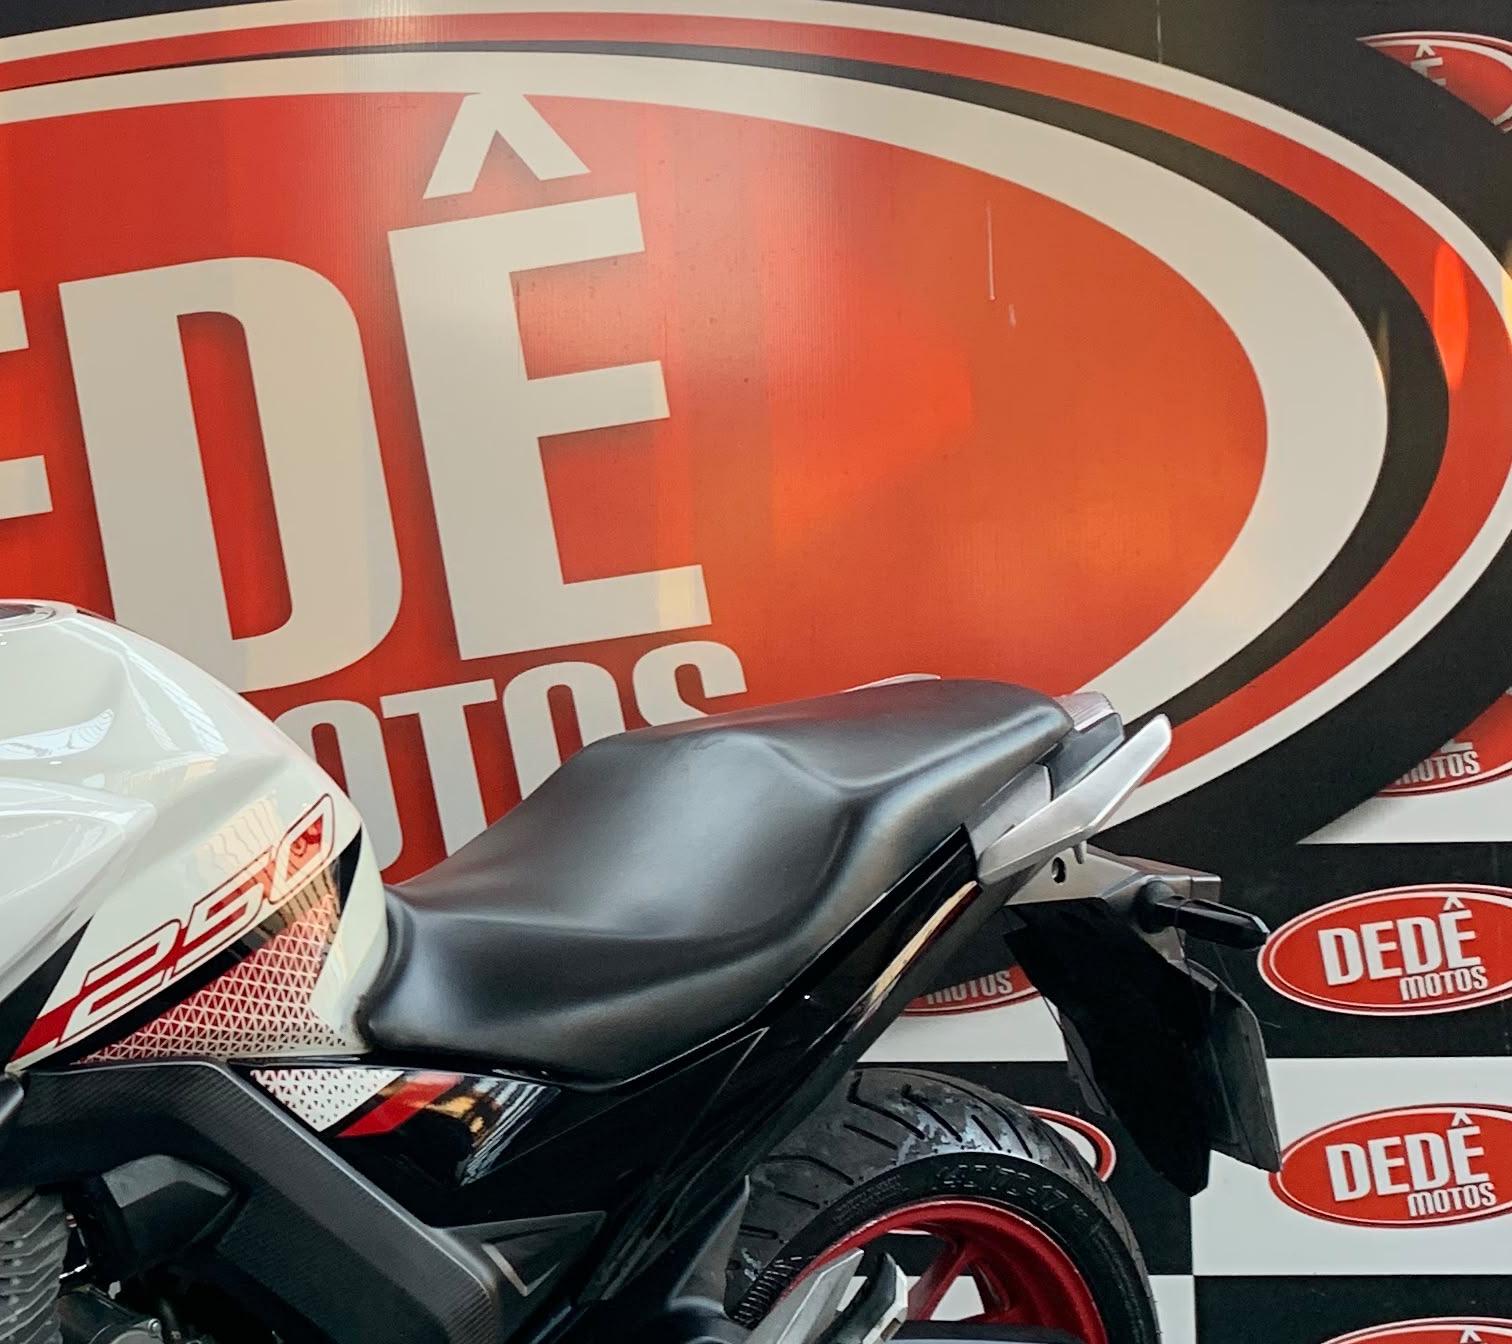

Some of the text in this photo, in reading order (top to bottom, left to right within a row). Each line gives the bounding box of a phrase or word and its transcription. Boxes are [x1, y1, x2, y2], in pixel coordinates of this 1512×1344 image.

[55, 793, 335, 1047] 250
[1318, 895, 1482, 986] DEDÊ
[1399, 966, 1489, 1001] MOTOS
[1325, 1111, 1490, 1202] DEDÊ
[1407, 1182, 1497, 1217] MOTOS
